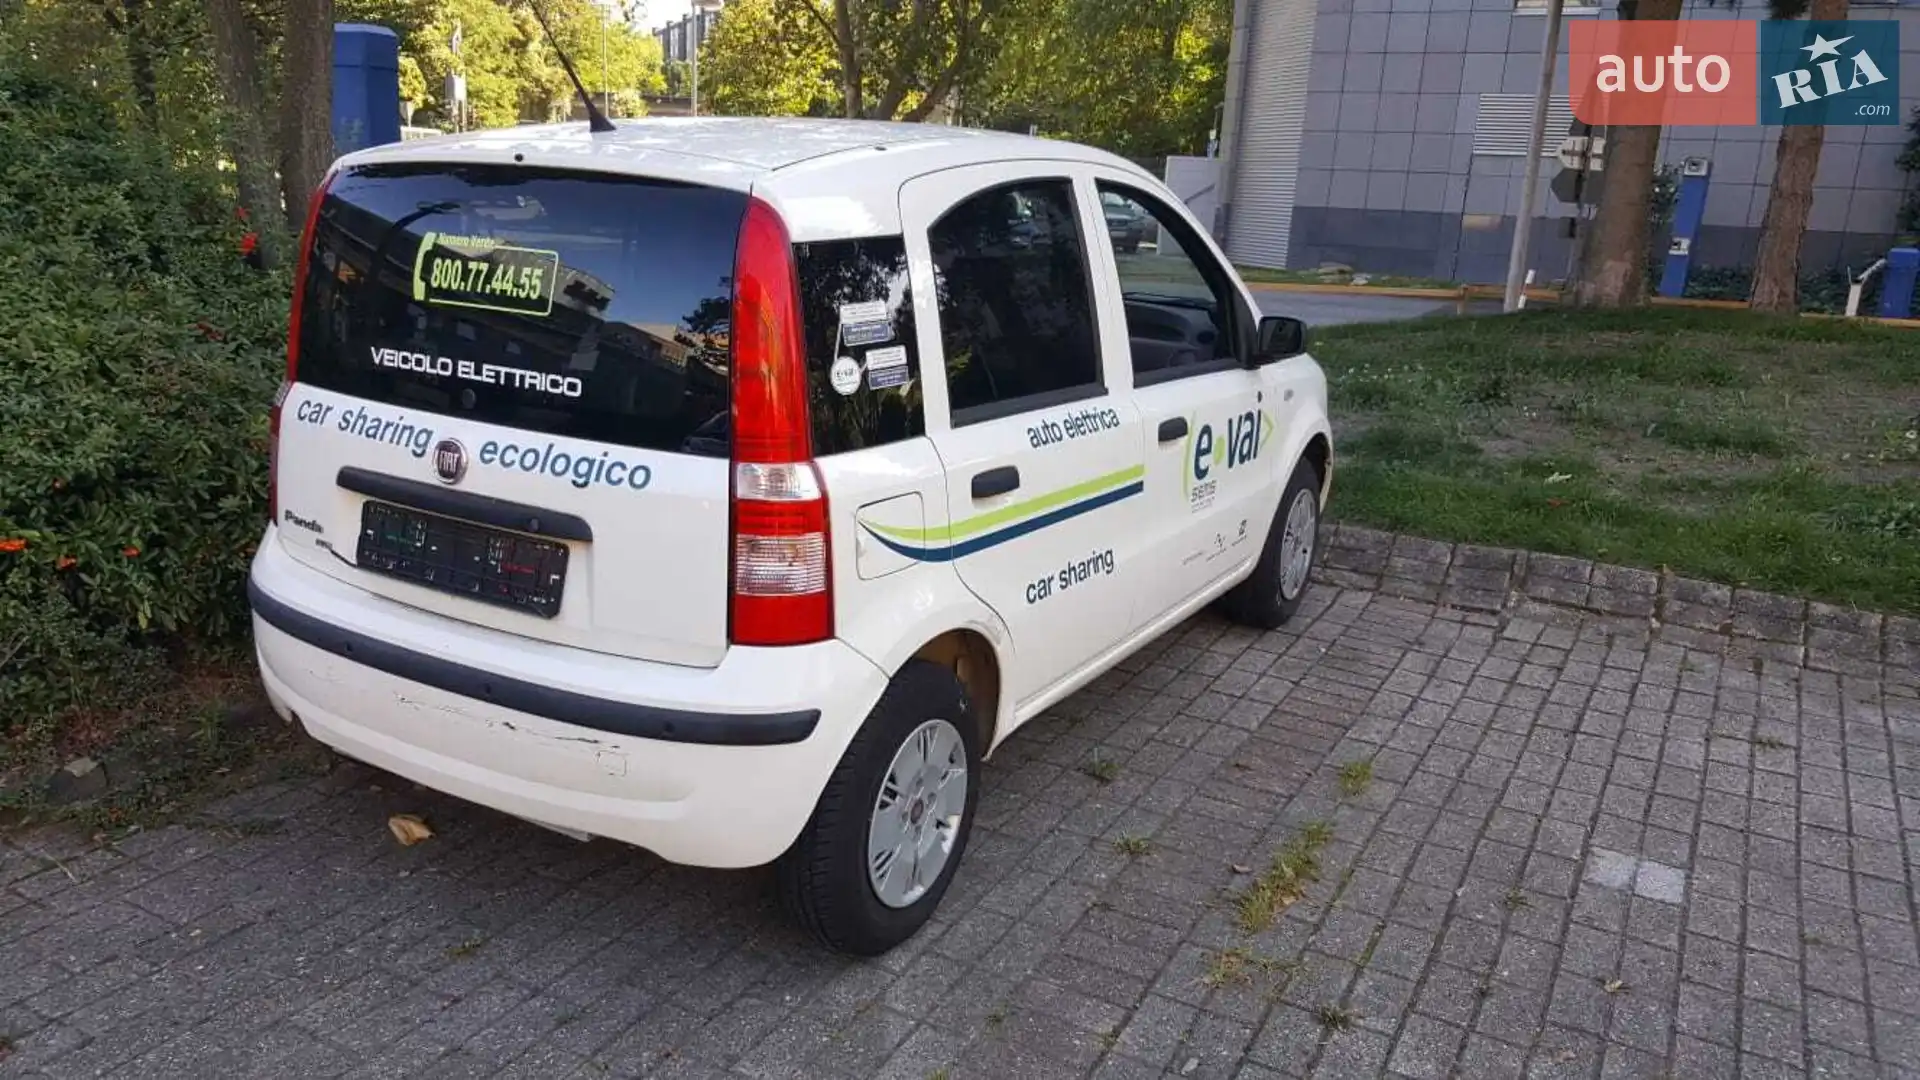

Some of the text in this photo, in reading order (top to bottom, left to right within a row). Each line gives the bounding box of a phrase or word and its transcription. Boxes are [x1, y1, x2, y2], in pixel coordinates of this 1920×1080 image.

[430, 257, 544, 300] 800.77.44.55
[371, 346, 582, 398] VEICOLO ELETTRICO
[297, 399, 652, 490] car sharing ecologico
[1027, 406, 1121, 449] auto elettrica
[1026, 548, 1115, 605] car sharing
